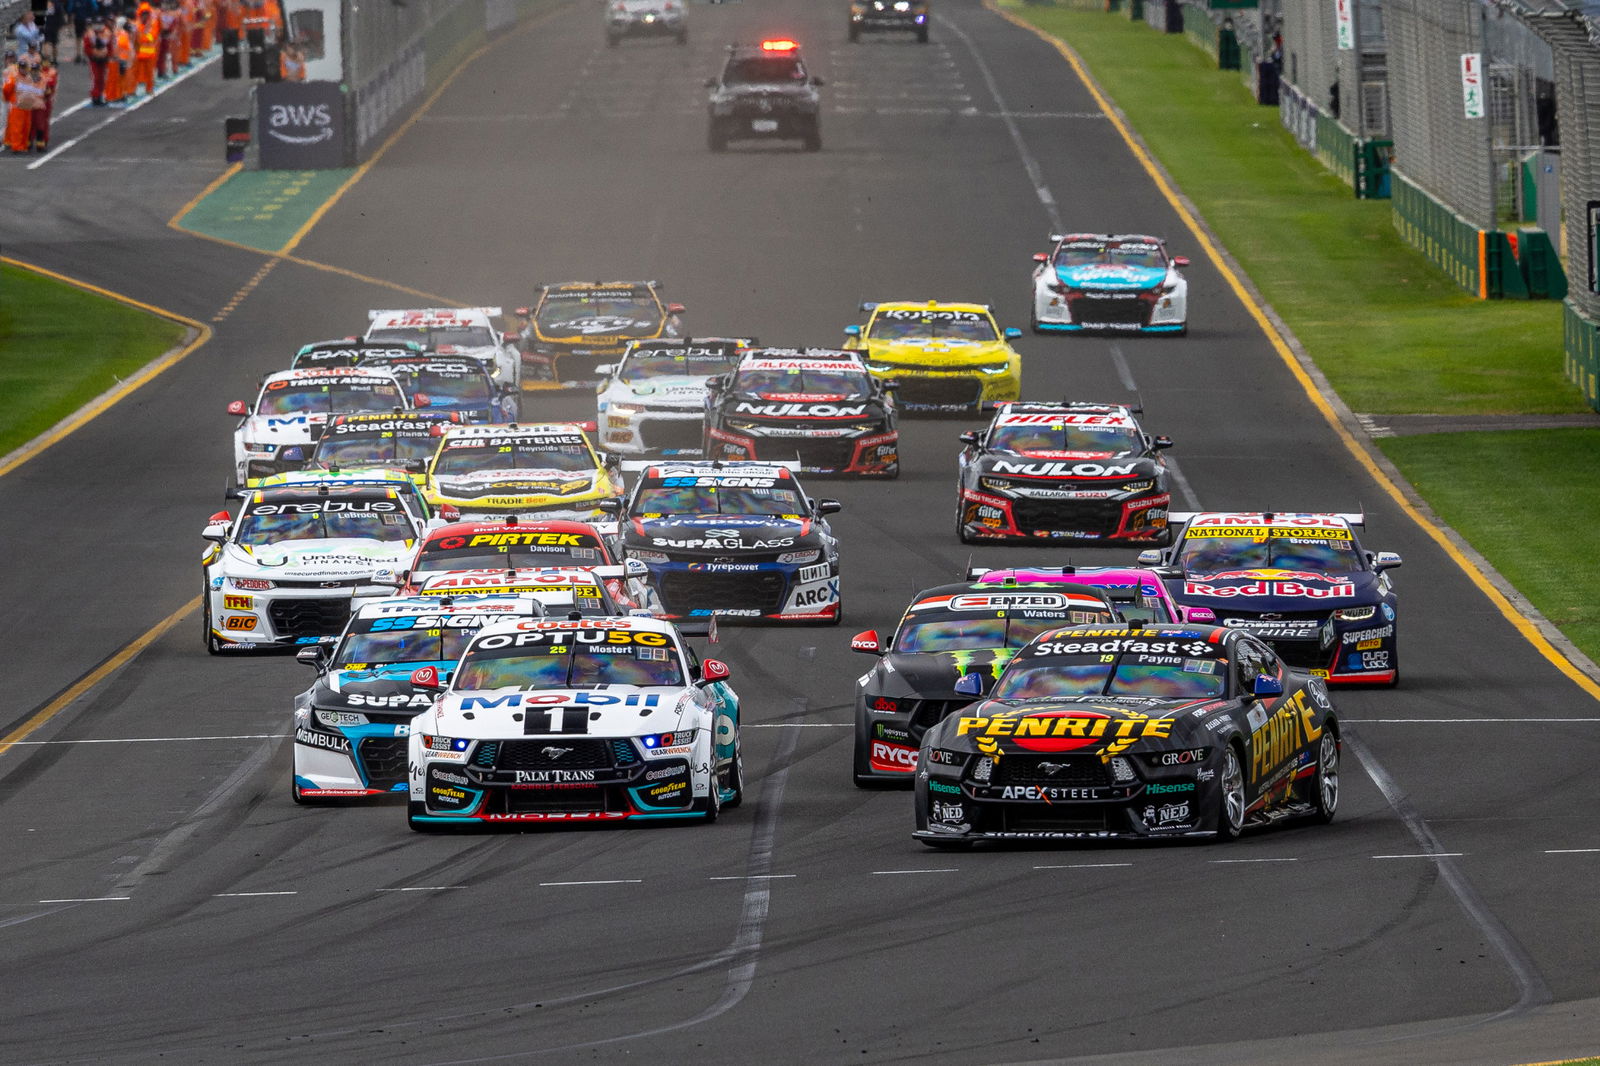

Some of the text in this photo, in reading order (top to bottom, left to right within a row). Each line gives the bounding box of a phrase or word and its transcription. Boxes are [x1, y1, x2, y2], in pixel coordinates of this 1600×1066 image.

[270, 103, 331, 127] aws
[378, 364, 468, 374] AYCO
[735, 402, 868, 417] NULON
[347, 413, 418, 422] PENRITE
[1004, 415, 1127, 425] HIFLEX
[336, 420, 430, 434] Steadfast
[489, 437, 583, 446] BATTERIES
[991, 460, 1137, 477] NULON
[252, 500, 397, 516] erebus
[1195, 517, 1344, 528] AMPOL
[1188, 528, 1348, 540] NATIONAL STORAGE
[469, 533, 584, 548] PIRTEK
[1289, 537, 1328, 545] Brown
[530, 545, 566, 553] Davison
[302, 554, 399, 564] Unsecured
[706, 562, 760, 572] Tyrepower
[243, 579, 270, 590] PEDDERS
[430, 575, 592, 588] AMPOL
[1185, 581, 1356, 598] Red Bull
[225, 597, 248, 608] TFH
[989, 596, 1056, 606] ENZED
[997, 610, 1005, 618] 6
[1023, 610, 1066, 618] Waters
[517, 620, 632, 630] Coates
[425, 629, 440, 637] 10
[1055, 628, 1159, 639] PENRITE
[1256, 628, 1312, 638] HIRE
[1342, 625, 1394, 645] SUPERCHEAP
[589, 645, 633, 654] Mostert
[851, 640, 877, 649] RYCO
[1034, 640, 1178, 656] Steadfast
[549, 646, 567, 654] 25
[1099, 654, 1114, 663] 19
[1138, 654, 1182, 664] Payne
[1362, 651, 1389, 661] QUAD
[1362, 660, 1389, 669] LOCK
[460, 692, 660, 710] Mobil
[543, 707, 565, 732] 1
[956, 717, 1175, 738] PENRITE
[432, 736, 451, 744] TRUCK
[674, 731, 692, 740] TRUCK
[672, 737, 692, 746] ASSIST
[431, 743, 451, 751] ASSIST
[425, 750, 463, 760] GEARWRENCH
[1161, 749, 1204, 766] GROVE
[515, 769, 595, 783] PALM TRANS
[432, 786, 465, 799] GOODYEAR
[650, 781, 687, 796] GOODYEAR
[929, 780, 961, 795] Hisense
[1145, 782, 1196, 795] Hisense
[1051, 788, 1099, 798] STEEL
[942, 807, 963, 819] NED
[1160, 805, 1190, 822] NED
